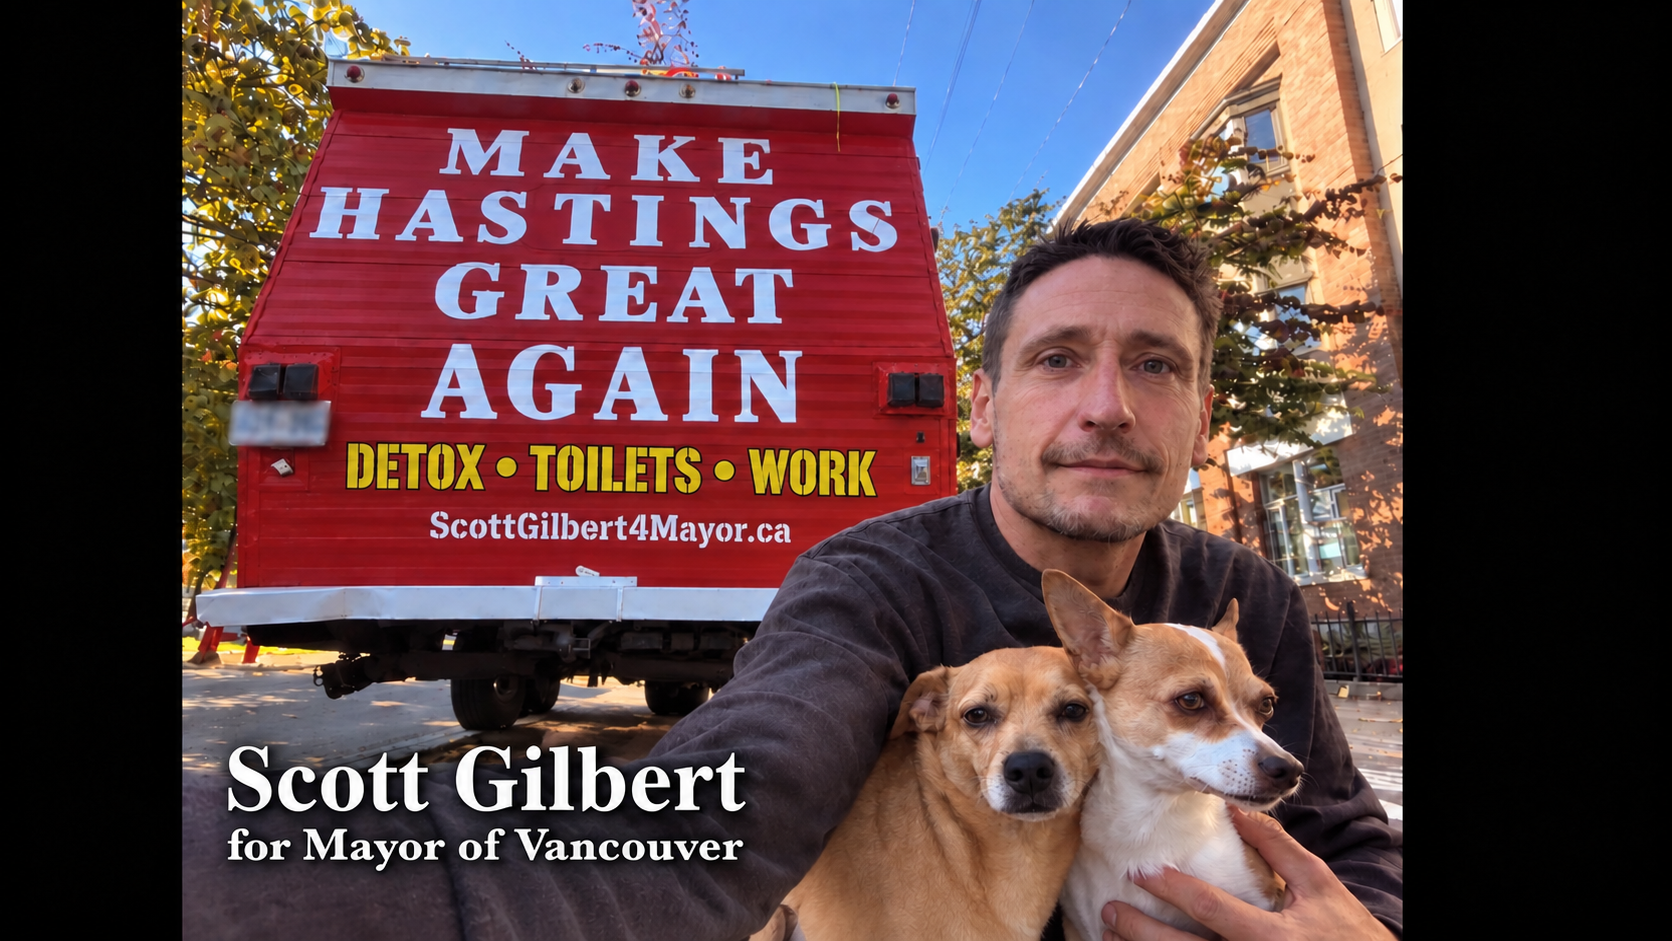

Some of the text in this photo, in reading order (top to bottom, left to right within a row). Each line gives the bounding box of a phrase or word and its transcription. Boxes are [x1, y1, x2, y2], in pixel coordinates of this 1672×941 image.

[439, 127, 773, 185] MAKE
[308, 186, 899, 253] HASTINGS
[434, 261, 794, 324] GREAT
[420, 343, 803, 423] AGAIN
[345, 442, 877, 497] DETOX TOILETS WORK
[429, 511, 792, 549] ScottGilbert4Mayor.ca
